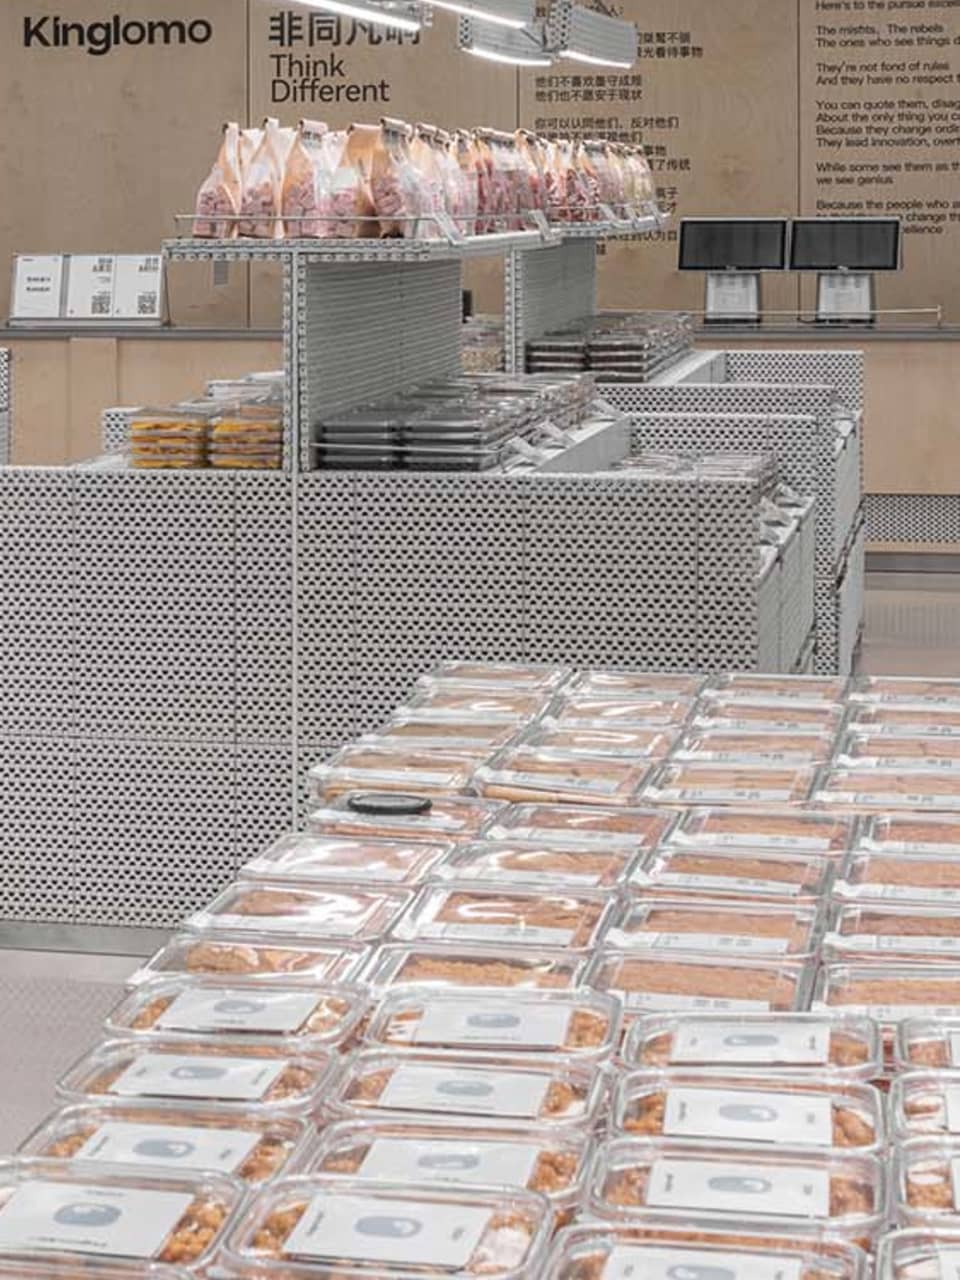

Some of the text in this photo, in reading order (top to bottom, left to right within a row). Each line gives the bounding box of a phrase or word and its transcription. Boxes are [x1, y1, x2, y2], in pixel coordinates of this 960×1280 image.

[853, 0, 865, 10] to
[867, 0, 885, 9] the
[817, 25, 837, 35] The
[887, 23, 908, 34] The
[24, 15, 212, 56] Kinglomo
[816, 38, 837, 48] The
[839, 39, 866, 47] ones
[868, 37, 892, 47] who
[894, 38, 914, 46] see
[917, 36, 950, 47] things
[269, 53, 345, 78] Think
[816, 61, 949, 73] They're not fond of rules
[816, 75, 839, 85] And
[840, 76, 864, 86] they
[867, 74, 893, 84] have
[896, 76, 910, 84] no
[912, 74, 953, 85] respect
[271, 78, 390, 103] Different
[816, 100, 838, 110] You
[840, 102, 860, 110] can
[863, 100, 895, 111] quote
[816, 112, 849, 122] About
[851, 112, 869, 122] the
[871, 112, 895, 123] only
[897, 111, 925, 123] thing
[927, 113, 948, 123] you
[816, 125, 863, 135] Because
[865, 125, 888, 136] they
[891, 125, 932, 136] change
[816, 138, 842, 149] They
[844, 137, 869, 147] lead
[816, 162, 847, 172] While
[849, 164, 879, 172] some
[881, 163, 902, 172] see
[904, 162, 933, 172] them
[935, 163, 949, 171] as
[857, 175, 894, 186] genius
[816, 201, 863, 209] Because
[865, 200, 884, 209] the
[886, 199, 923, 210] people
[925, 200, 950, 209] who
[905, 211, 947, 223] change
[903, 224, 944, 234] ellence
